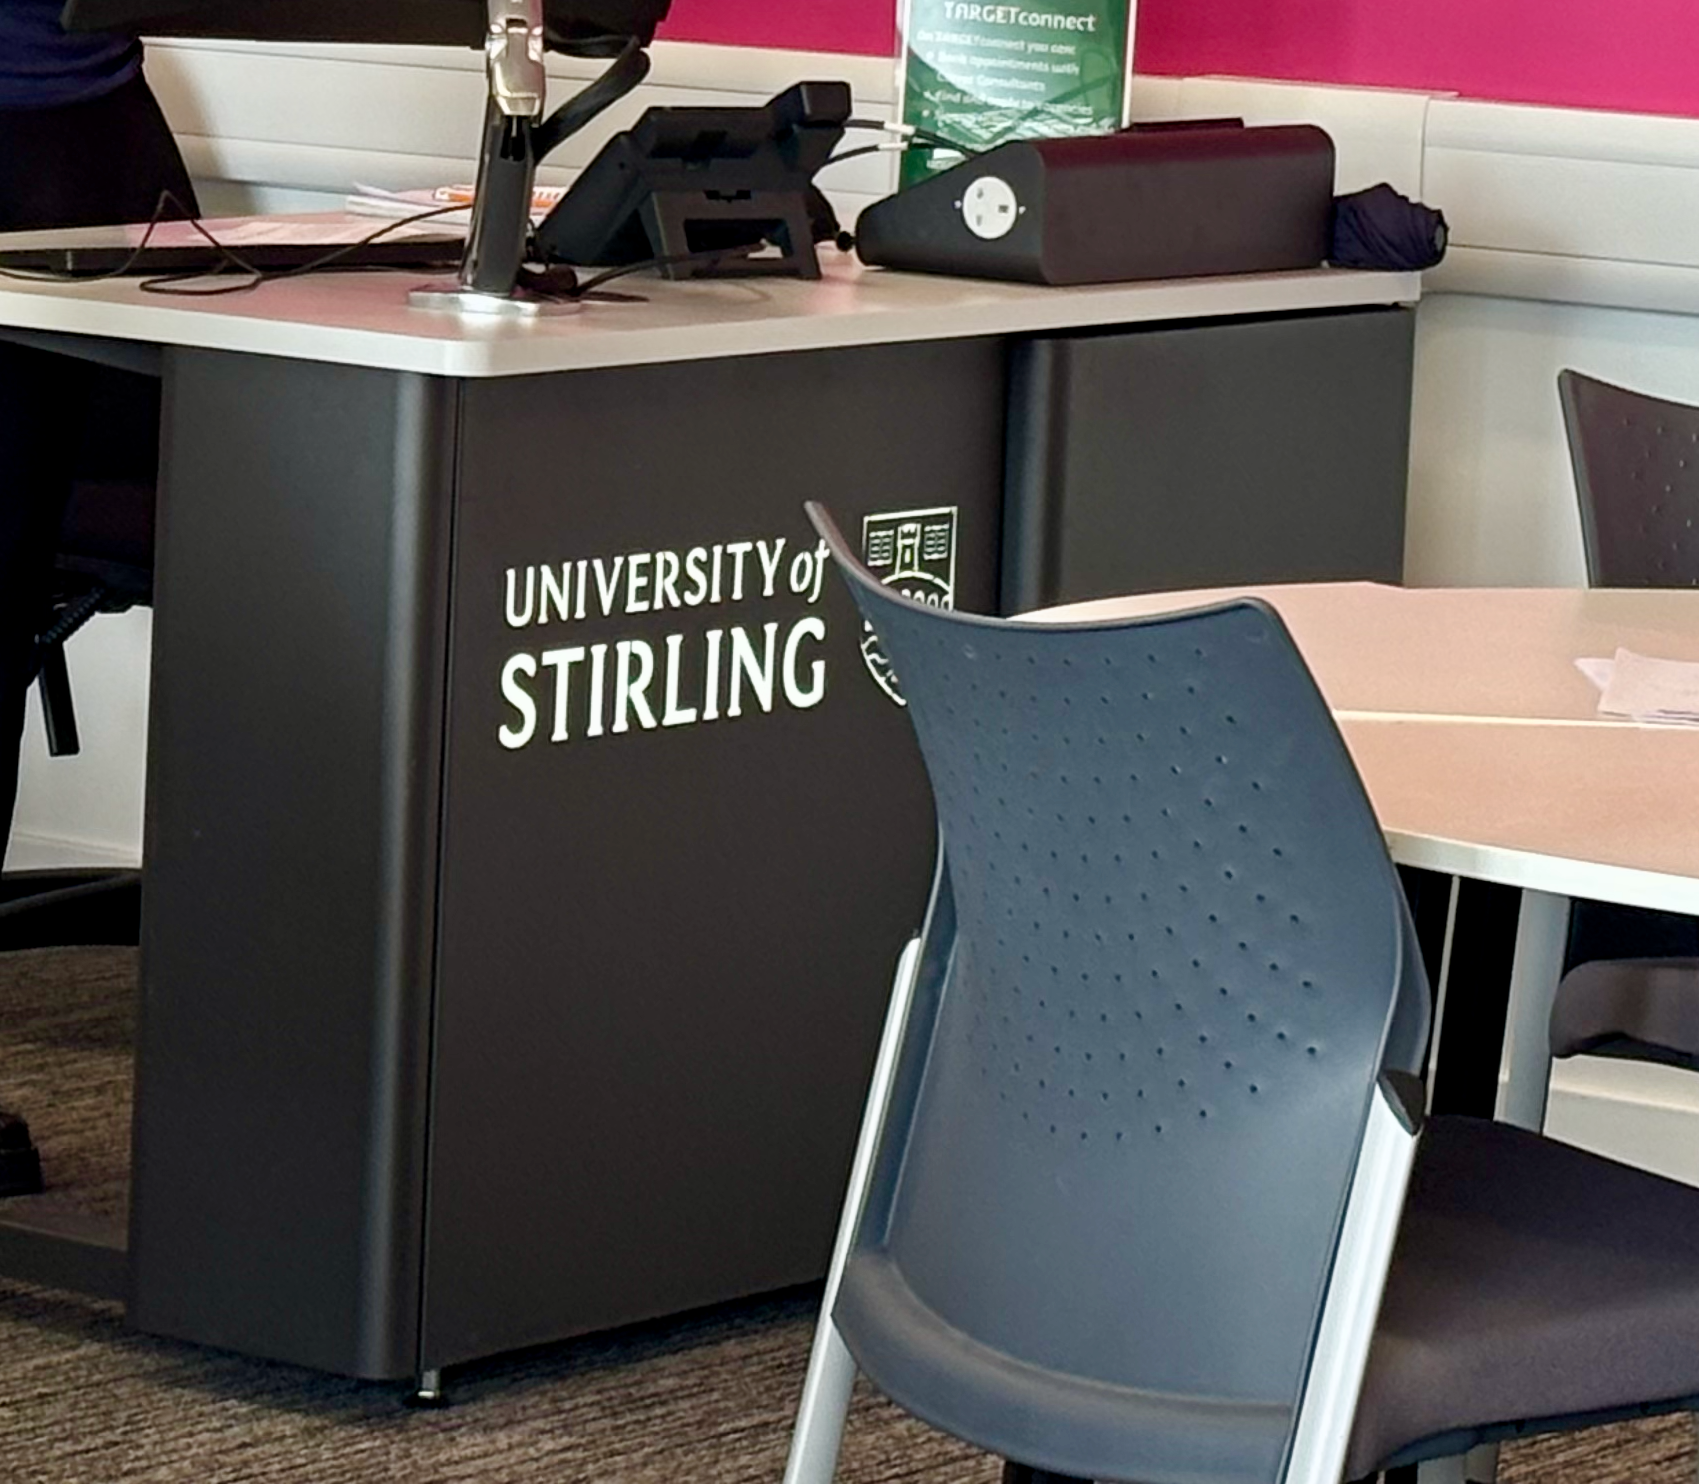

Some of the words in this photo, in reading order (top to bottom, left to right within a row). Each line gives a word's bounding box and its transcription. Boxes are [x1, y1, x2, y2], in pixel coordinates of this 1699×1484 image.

[943, 0, 1096, 32] TARGETconnect
[505, 537, 787, 628] UNIVERSITY
[789, 538, 831, 604] of
[498, 616, 826, 750] STIRLING
